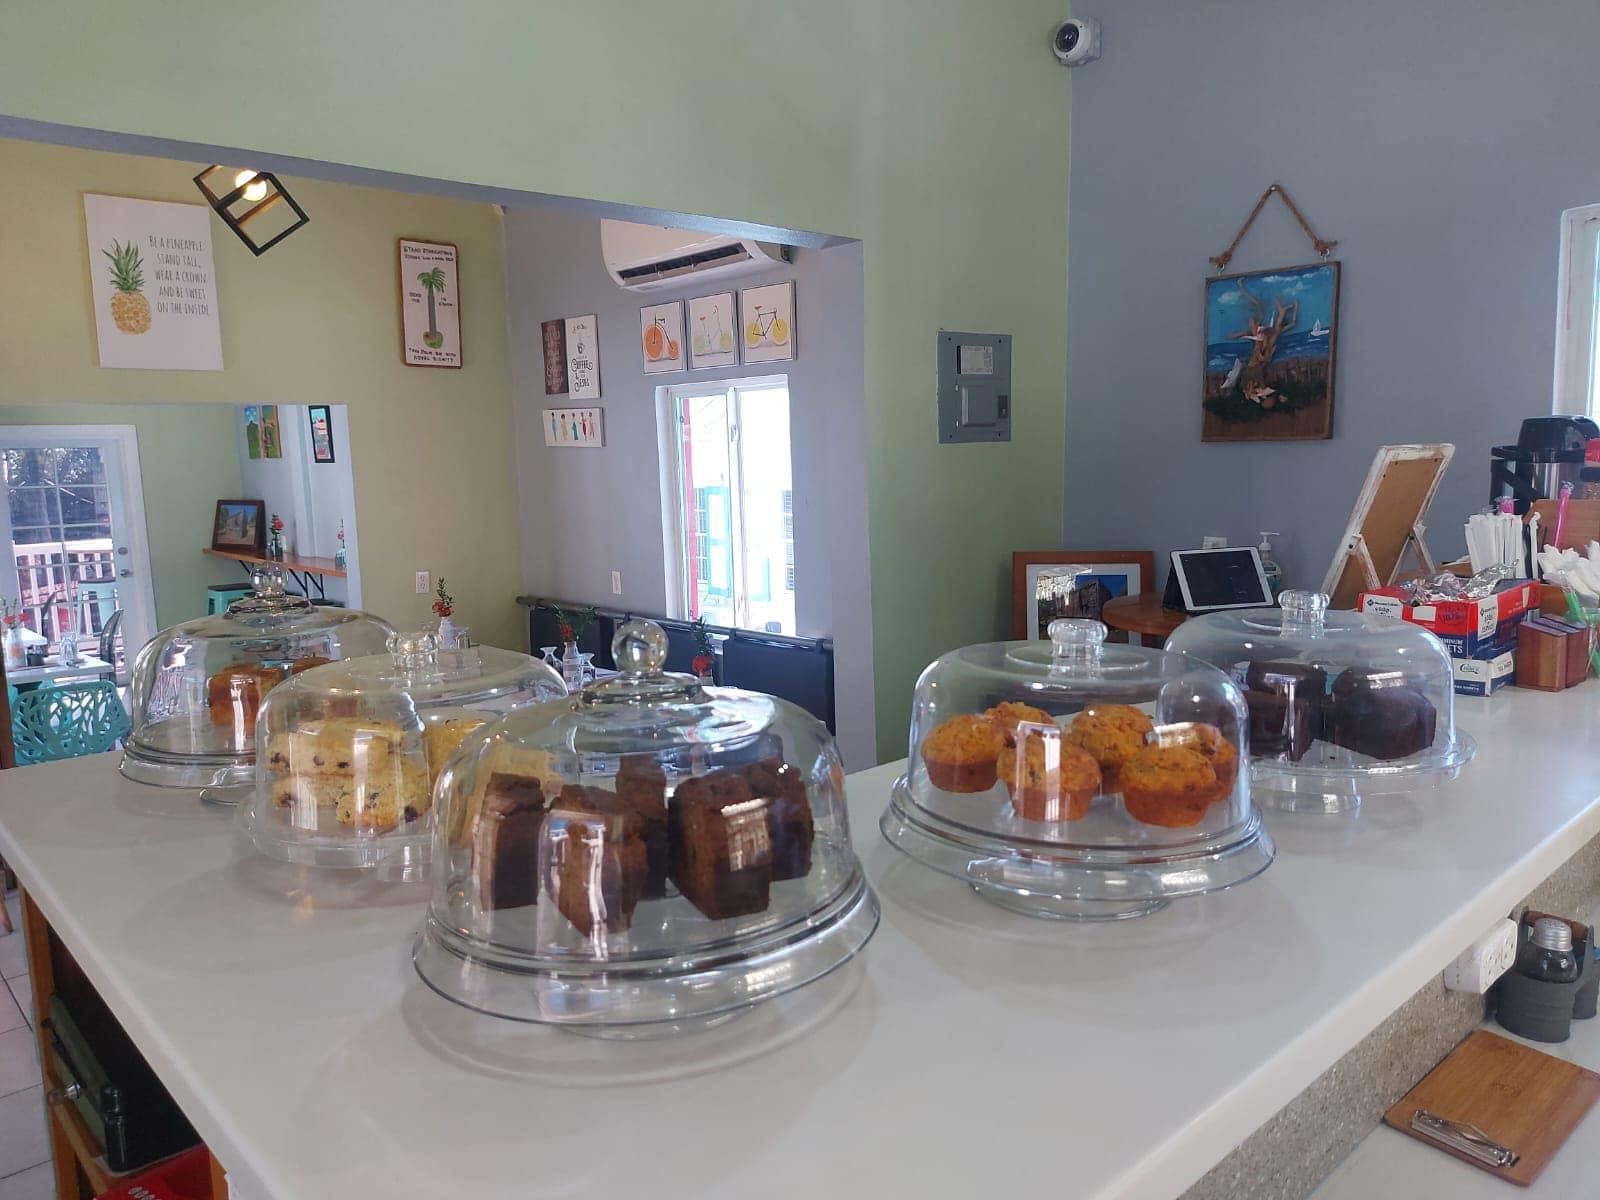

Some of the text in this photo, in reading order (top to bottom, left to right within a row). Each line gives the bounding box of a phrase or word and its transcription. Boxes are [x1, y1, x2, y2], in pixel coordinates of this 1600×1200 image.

[149, 235, 202, 252] BE A PINEAPPLE
[157, 254, 181, 266] STAND
[156, 270, 207, 284] WEAR A CROWN
[159, 286, 207, 300] AND BE SWEET
[157, 302, 169, 313] ON
[170, 303, 183, 315] THE
